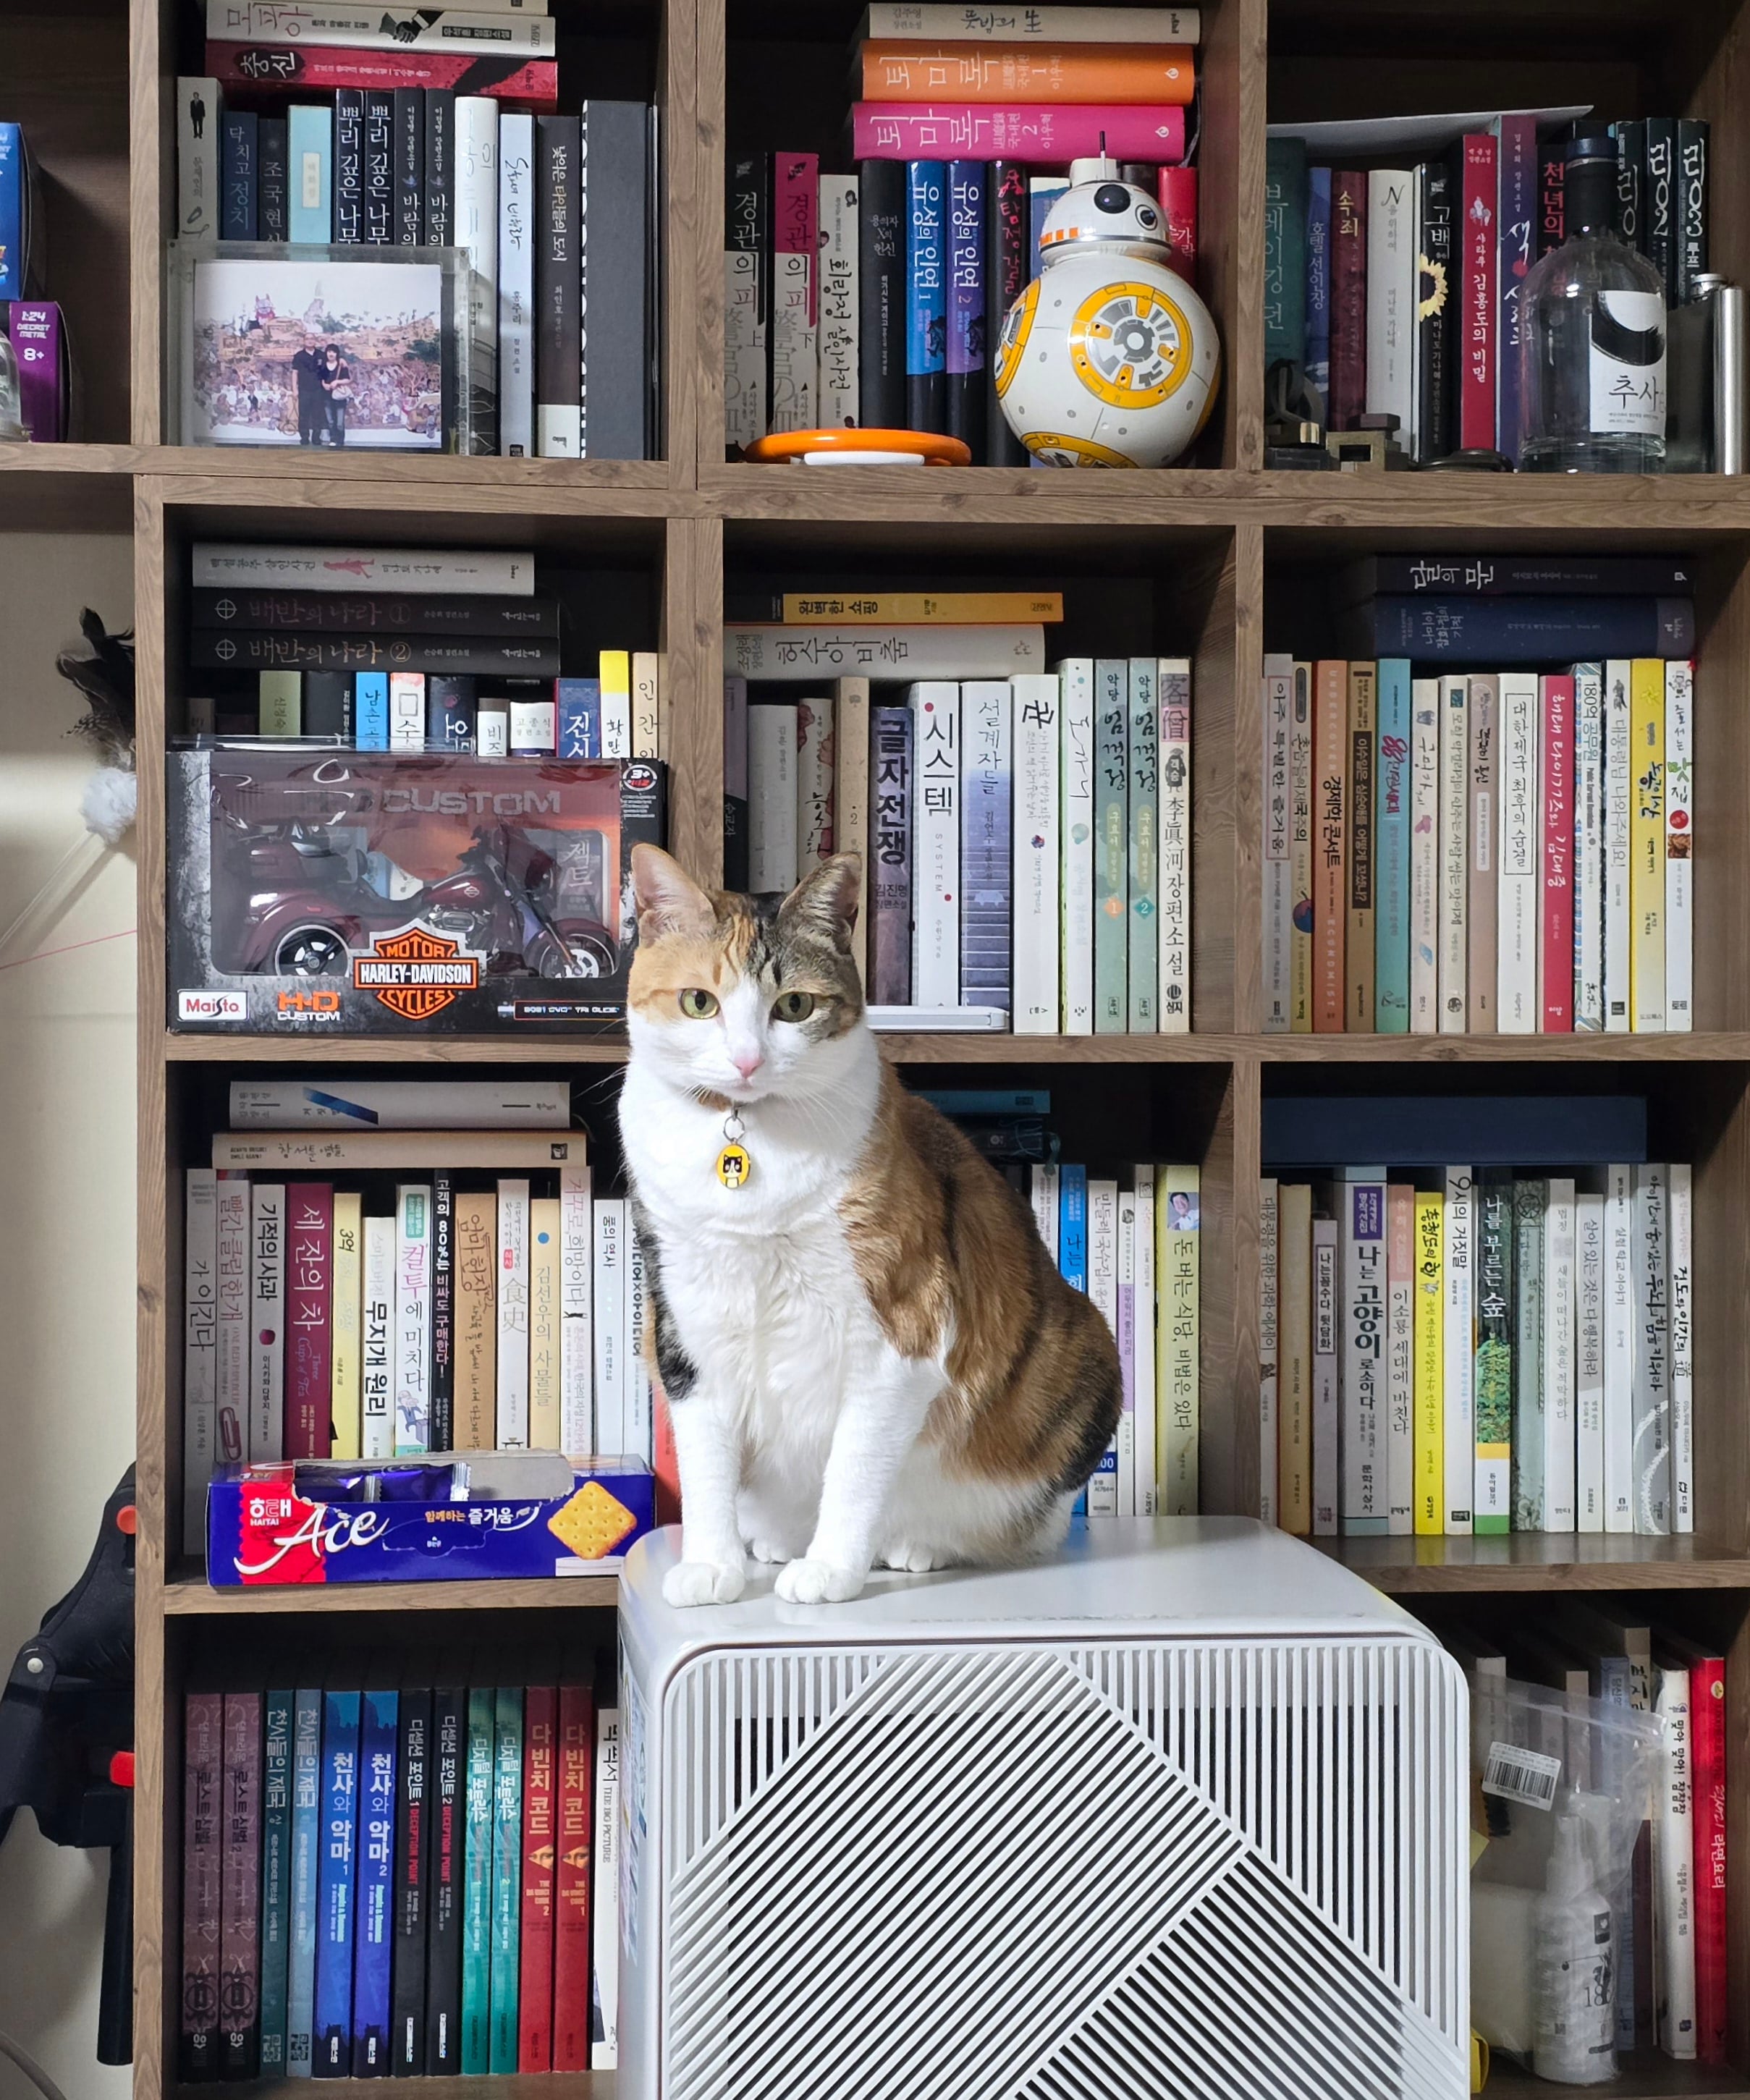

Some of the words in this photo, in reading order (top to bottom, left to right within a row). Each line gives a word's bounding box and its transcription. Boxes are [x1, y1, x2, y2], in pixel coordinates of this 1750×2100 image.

[227, 1, 313, 36] 모피아
[240, 51, 295, 78] 충신
[339, 106, 362, 149] 뿌리
[368, 105, 392, 149] 뿌리
[1022, 125, 1039, 135] 2
[229, 126, 251, 175] 닥치고
[552, 145, 567, 182] 낯익은
[339, 153, 361, 198] 깊은
[368, 152, 391, 198] 깊은
[230, 181, 249, 231] 정치
[339, 204, 361, 244] 나무
[368, 203, 390, 245] 나무
[551, 185, 567, 233] 타인들의
[870, 215, 900, 227] 용의자
[912, 181, 939, 240] 유성의
[952, 181, 979, 240] 유성의
[1337, 190, 1359, 237] 속죄
[551, 237, 568, 261] 도시
[734, 192, 761, 284] 경관의
[785, 192, 813, 284] 경관의
[874, 243, 897, 257] 헌신
[1309, 221, 1325, 254] 호텔
[913, 249, 940, 288] 인연
[953, 249, 980, 288] 인연
[1308, 257, 1326, 310] 선인장
[735, 284, 756, 314] 피
[786, 286, 808, 316] 피
[824, 258, 853, 321] 회랑정
[959, 295, 973, 304] 2
[22, 311, 46, 322] 1:24
[23, 348, 45, 361] 8+
[746, 331, 764, 348] 上
[799, 333, 815, 350] 下
[824, 326, 853, 391] 살인사건
[1472, 348, 1487, 383] 비밀
[209, 558, 262, 570] 백설공주
[265, 559, 316, 572] 살인사건
[382, 564, 410, 575] 미나토
[413, 565, 443, 575] 가나에
[798, 601, 845, 615] 완벽한
[849, 601, 879, 615] 쇼핑
[1452, 615, 1463, 640] 기적
[331, 639, 383, 663] 나라
[775, 636, 909, 665] 허수아비춤
[1107, 673, 1120, 703] 악당
[1138, 674, 1151, 704] 악당
[1272, 683, 1286, 723] 아주
[1583, 681, 1599, 719] 180억
[517, 717, 551, 727] 고종석
[1328, 669, 1338, 771] UNDERCOVER
[1550, 694, 1565, 734] 해태
[1272, 729, 1285, 789] 특별한
[1355, 738, 1369, 782] 이수일은
[1582, 721, 1599, 761] 공무원
[1610, 719, 1628, 779] 대통령님
[876, 719, 910, 865] 글자전쟁
[1324, 776, 1342, 822] 경제학
[1355, 784, 1369, 826] 심순애를
[1271, 795, 1285, 855] 즐거움
[1610, 785, 1628, 868] 나와주세요!
[934, 833, 943, 892] SYSTEM
[1323, 824, 1341, 868] 콘서트
[1354, 829, 1368, 861] 어떻게
[1547, 835, 1565, 887] 김대중
[1111, 902, 1118, 913] 1
[1141, 902, 1149, 914] 2
[1165, 873, 1185, 976] 장편소설
[386, 943, 445, 959] MOTOR
[1327, 918, 1337, 1007] ECONOMIST
[360, 963, 472, 985] HARLEY-DAVIDSON
[277, 1011, 340, 1021] CUSTOM
[387, 989, 446, 1013] CYCLES
[220, 1195, 245, 1235] 빨간
[293, 1203, 326, 1229] 세
[436, 1179, 450, 1216] 고객의
[1448, 1176, 1471, 1219] 9시의
[1484, 1194, 1502, 1229] 나를
[257, 1204, 278, 1259] 기적의
[338, 1228, 355, 1252] 3억
[1261, 1197, 1277, 1250] 대통령을
[1420, 1208, 1440, 1259] 충청도의
[1583, 1219, 1599, 1247] 살아
[220, 1238, 244, 1276] 클립
[293, 1238, 324, 1292] 잔의
[436, 1220, 450, 1271] 80%는
[602, 1243, 616, 1268] 역사
[1174, 1238, 1193, 1258] 돈
[1358, 1245, 1382, 1279] 나는
[1451, 1226, 1468, 1270] 거짓말
[1483, 1235, 1502, 1287] 부르는
[1583, 1250, 1599, 1276] 있는
[256, 1262, 278, 1301] 사과
[564, 1235, 586, 1306] 희망이다
[1174, 1261, 1193, 1298] 버는
[1261, 1253, 1276, 1279] 위한
[436, 1274, 450, 1311] 비싸도
[502, 1277, 528, 1334] 食史
[535, 1266, 552, 1343] 김선우의
[1261, 1282, 1276, 1309] 과학
[1481, 1292, 1507, 1318] 숲
[1583, 1279, 1599, 1306] 것은
[292, 1302, 324, 1331] 차
[1174, 1302, 1193, 1342] 식당,
[1261, 1311, 1276, 1351] 에세이
[1319, 1314, 1332, 1350] 뒷담화
[1392, 1290, 1410, 1335] 이소룡
[1583, 1308, 1598, 1323] 다
[1674, 1311, 1689, 1352] 인간의
[365, 1300, 387, 1366] 무지개
[436, 1315, 449, 1379] 구매한다!
[1352, 1284, 1385, 1411] 고양이로소이다
[1583, 1324, 1599, 1377] 행복하라
[312, 1353, 322, 1381] Three
[534, 1350, 553, 1407] 사물들
[1175, 1349, 1193, 1396] 비법은
[1392, 1339, 1410, 1384] 세대에
[365, 1372, 387, 1417] 원리
[1392, 1391, 1410, 1435] 바친다
[1174, 1400, 1193, 1431] 있다
[1361, 1464, 1374, 1513] 문학사상사
[468, 1509, 513, 1525] 즐거움
[233, 1505, 389, 1575] Ace
[266, 1709, 288, 1773] 천사들의
[296, 1709, 318, 1773] 천사들의
[407, 1719, 424, 1757] 디셉션
[441, 1715, 457, 1754] 디셉션
[266, 1776, 287, 1808] 제국
[295, 1776, 316, 1808] 제국
[331, 1752, 354, 1813] 천사와
[370, 1753, 392, 1814] 천사와
[407, 1761, 423, 1800] 포인트
[440, 1758, 457, 1796] 포인트
[269, 1814, 283, 1825] 상
[407, 1808, 420, 1856] DECEPTION
[441, 1805, 452, 1854] DECEPTION
[528, 1797, 551, 1836] 코드
[564, 1798, 586, 1837] 코드
[330, 1819, 352, 1862] 악마
[368, 1820, 390, 1863] 악마
[343, 1865, 348, 1875] 1
[379, 1864, 388, 1876] 2
[407, 1858, 419, 1885] POINT
[440, 1857, 451, 1883] POINT
[543, 1905, 550, 1916] 2
